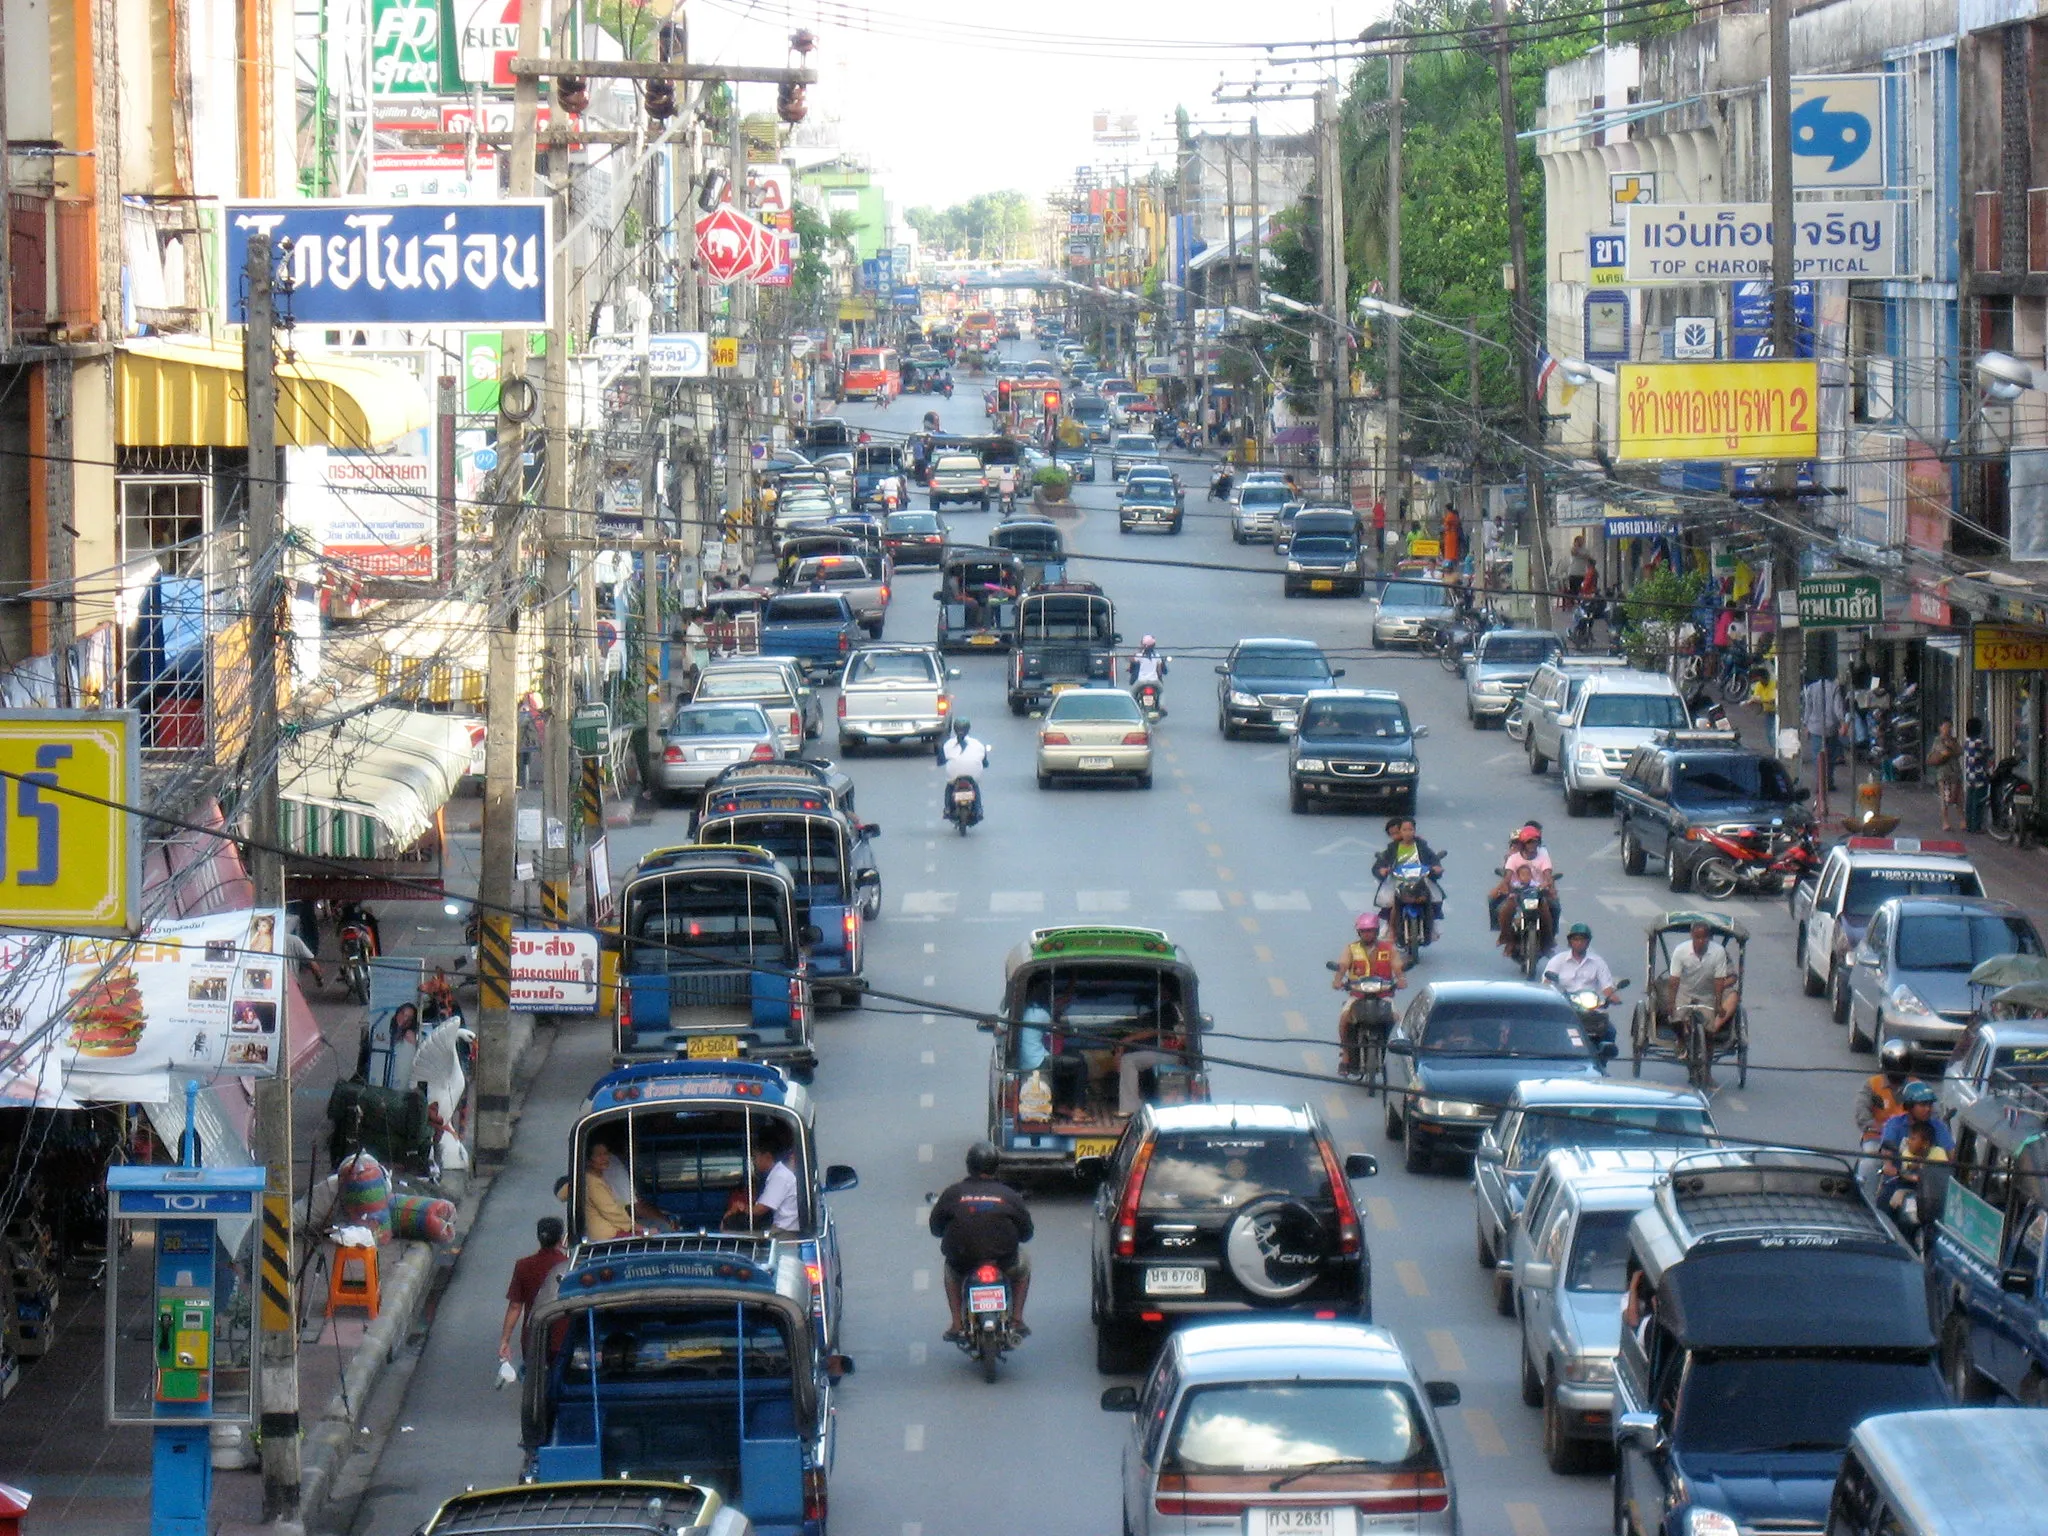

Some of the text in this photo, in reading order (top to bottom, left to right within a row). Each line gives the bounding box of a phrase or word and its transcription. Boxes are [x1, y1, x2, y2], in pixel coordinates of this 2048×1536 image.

[1650, 260, 1686, 274] TOP
[1628, 376, 1808, 449] ห้างทองบูรพา 2
[153, 1193, 217, 1210] TOT
[1280, 1254, 1320, 1264] CR-V
[1296, 1511, 1331, 1526] 2631
